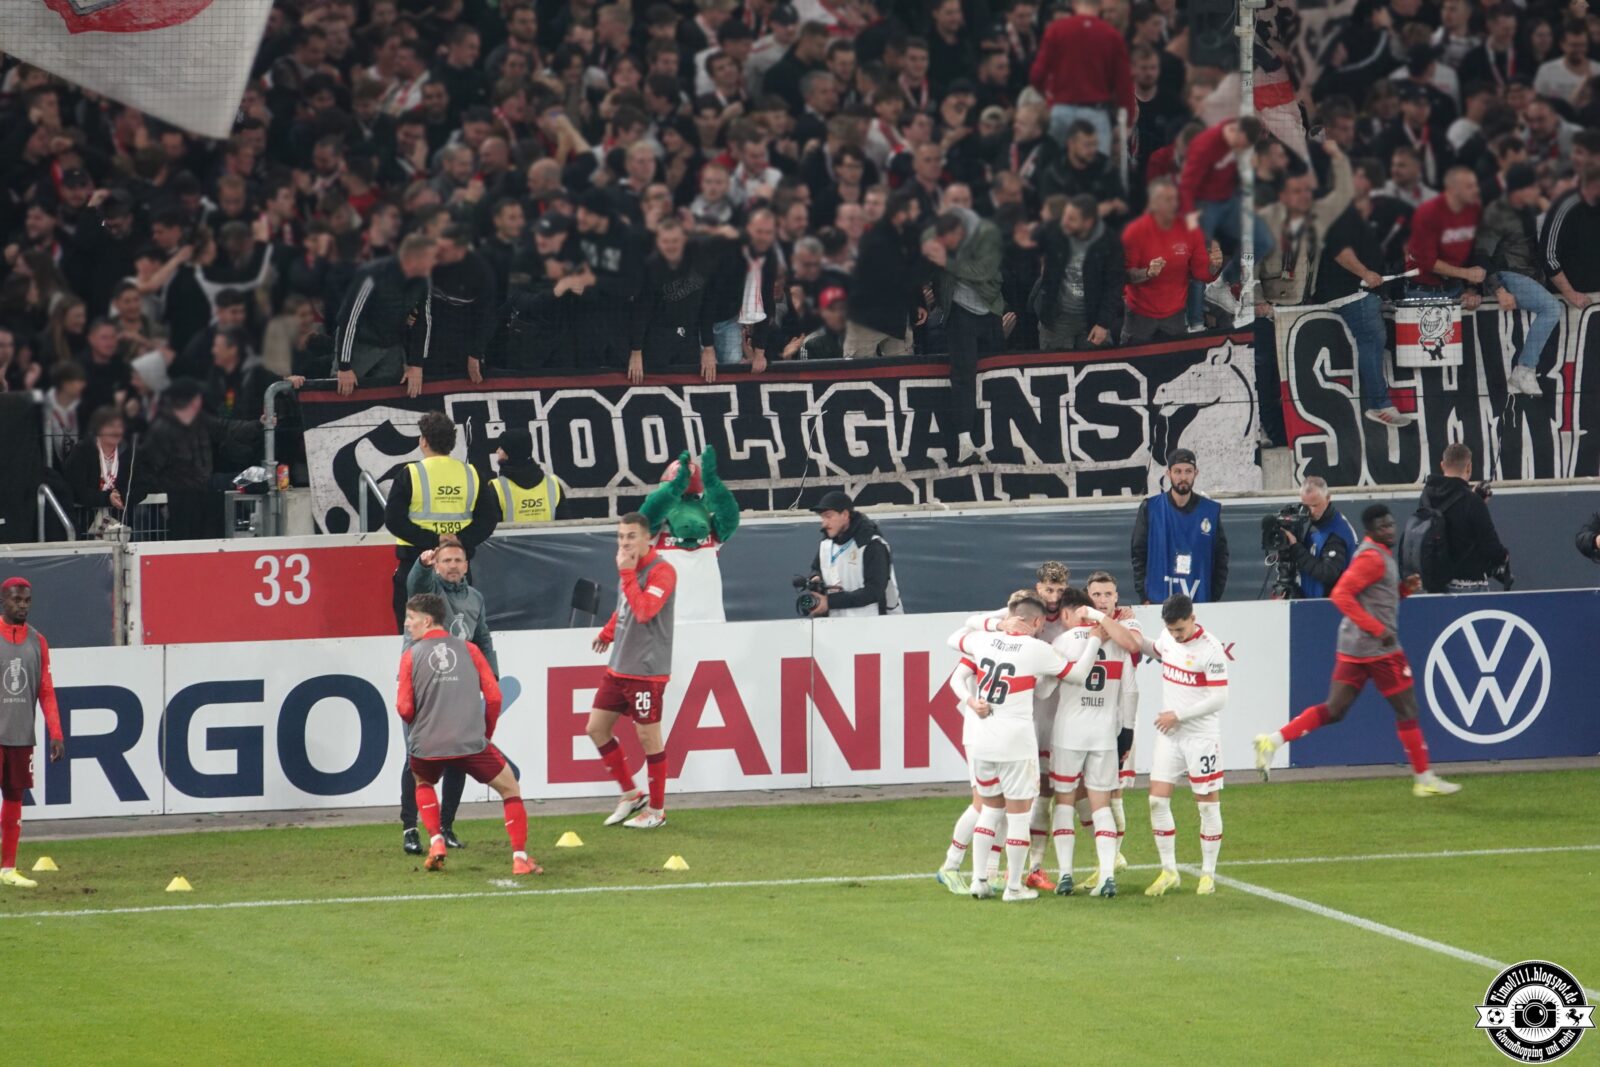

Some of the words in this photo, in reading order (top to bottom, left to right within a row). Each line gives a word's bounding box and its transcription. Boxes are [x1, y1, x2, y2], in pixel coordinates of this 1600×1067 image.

[1287, 308, 1600, 487] SCHW
[444, 362, 1150, 491] HOOLIGANS
[437, 486, 461, 495] SDS
[521, 498, 543, 508] SDS
[433, 522, 462, 534] 1589
[254, 553, 311, 606] 33
[1164, 575, 1201, 600] TV
[979, 657, 1016, 705] 26
[635, 691, 651, 710] 26
[1, 673, 390, 807] RGO
[1200, 755, 1216, 774] 32
